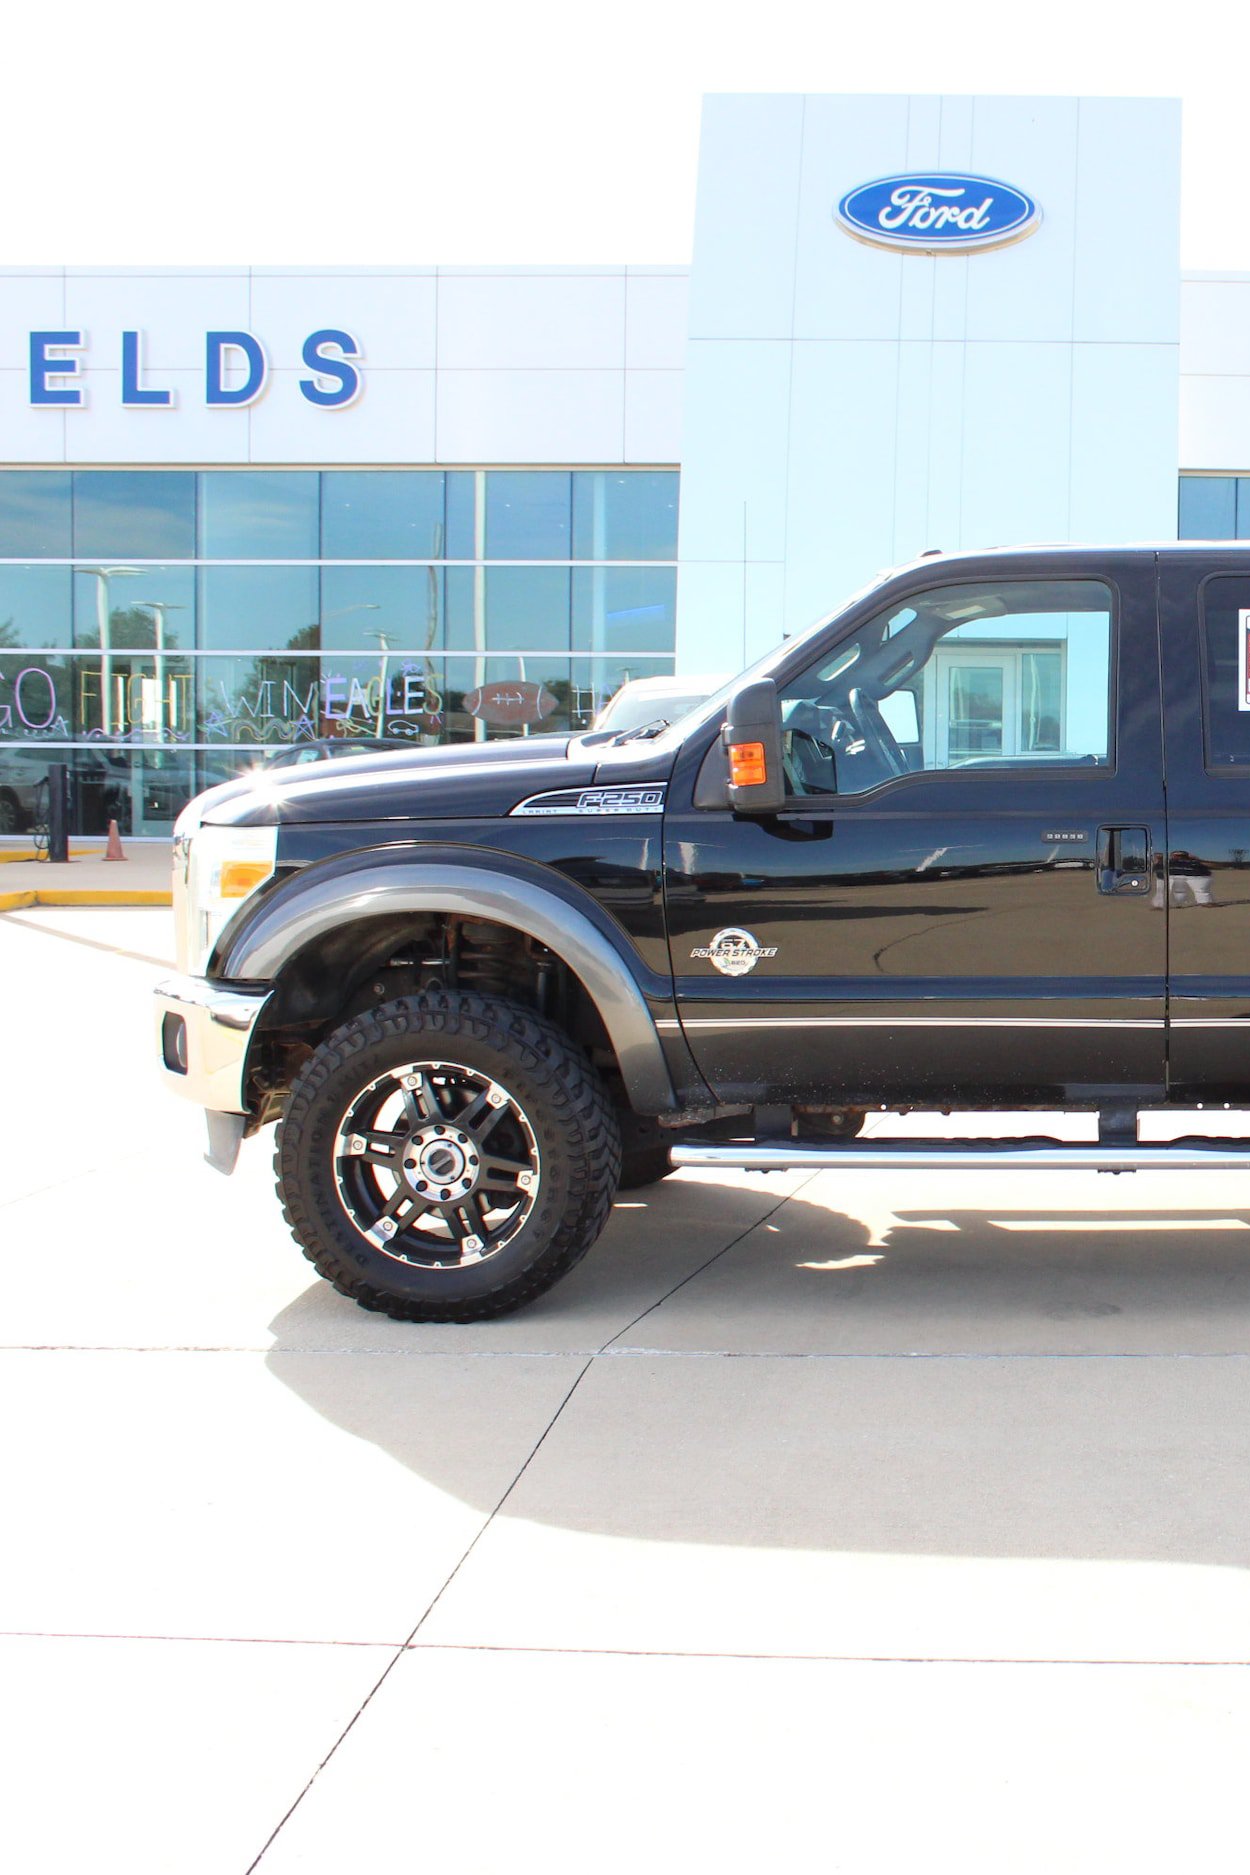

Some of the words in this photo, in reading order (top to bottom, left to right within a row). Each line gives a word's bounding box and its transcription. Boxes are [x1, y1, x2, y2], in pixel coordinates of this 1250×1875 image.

[878, 185, 994, 230] Ford
[28, 329, 362, 410] ELDS
[219, 678, 319, 718] WIN
[324, 673, 443, 720] EAGLES
[576, 791, 664, 808] F-250
[691, 948, 731, 957] POWER
[731, 948, 778, 957] STROKE
